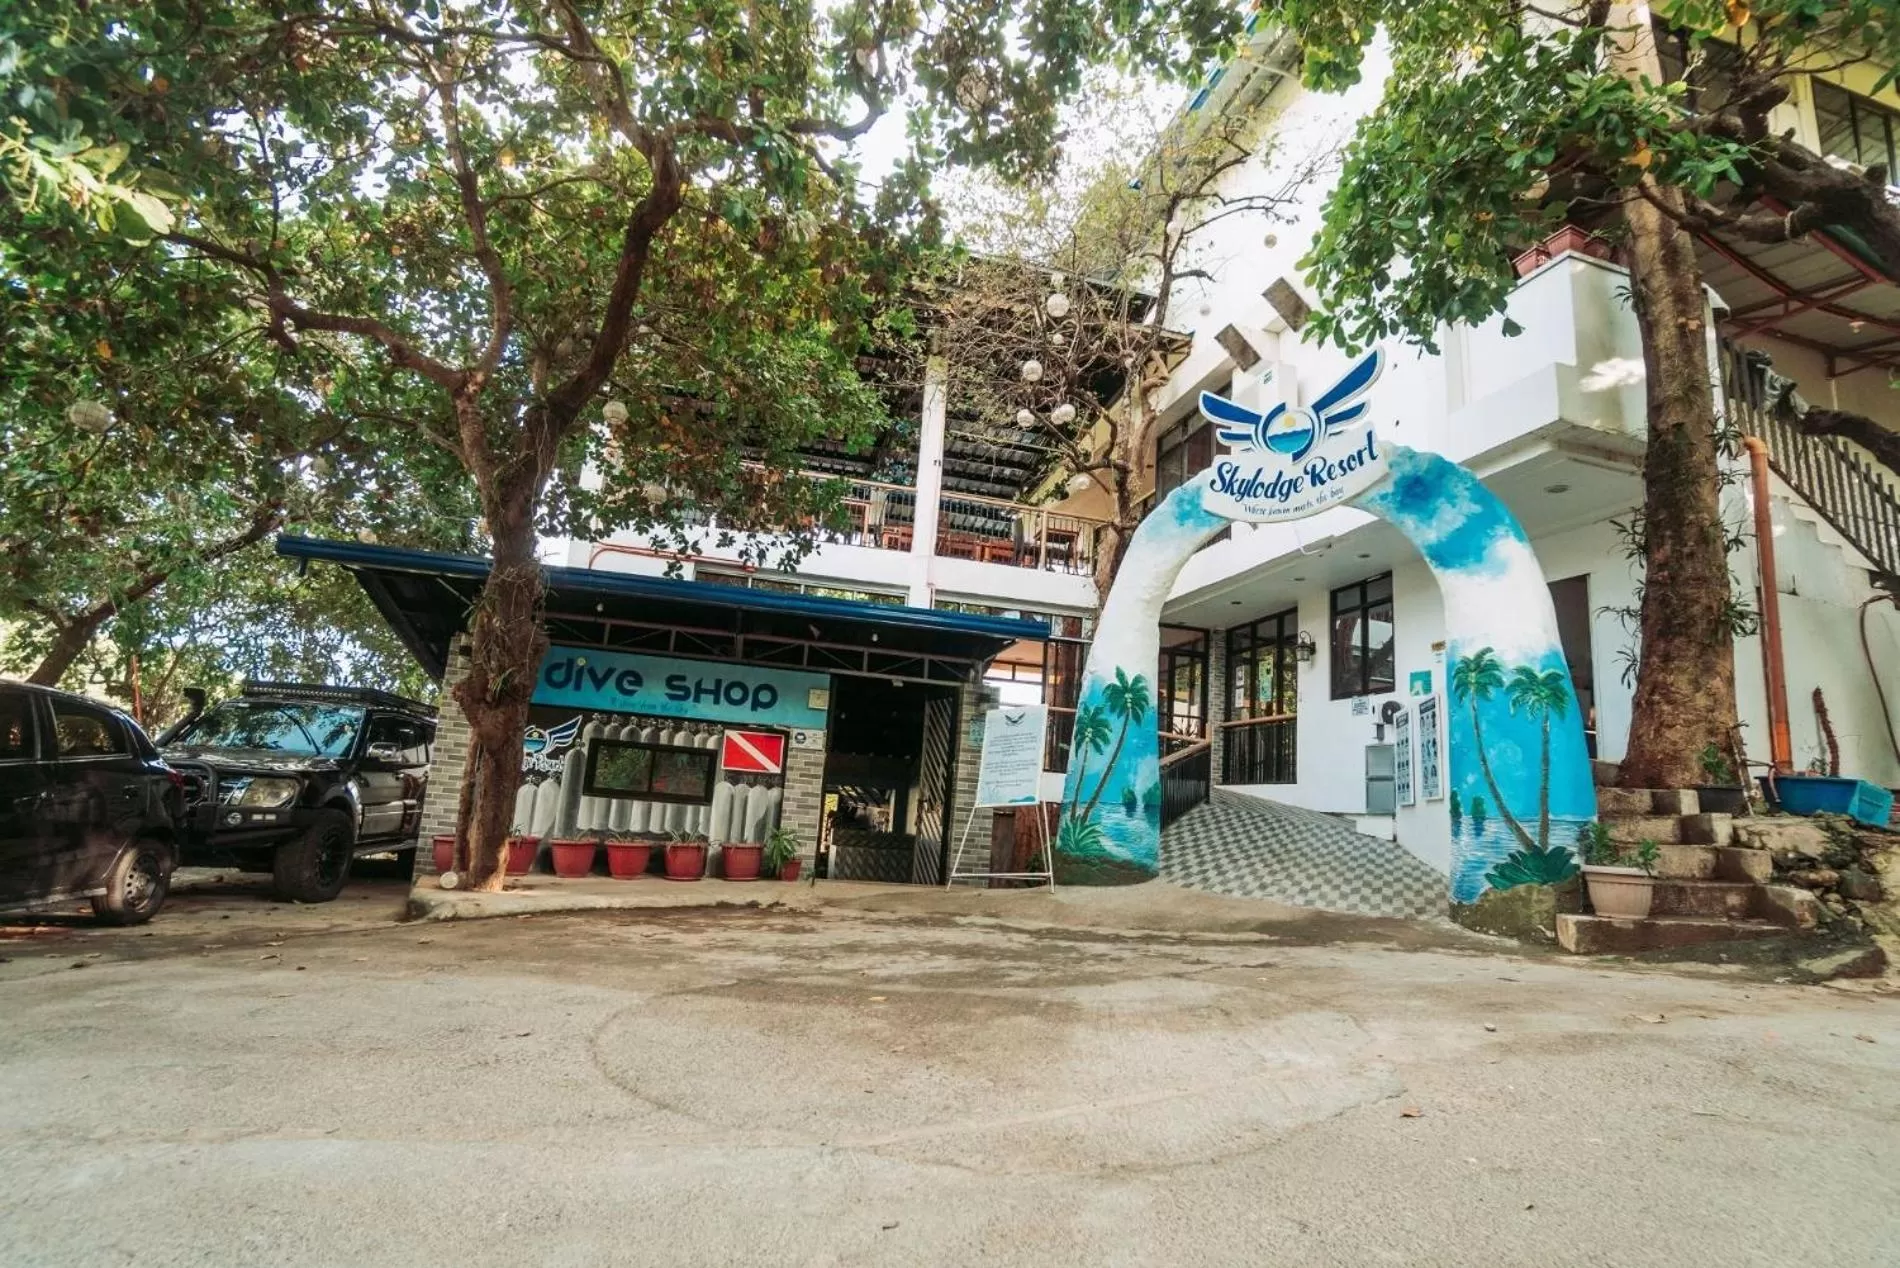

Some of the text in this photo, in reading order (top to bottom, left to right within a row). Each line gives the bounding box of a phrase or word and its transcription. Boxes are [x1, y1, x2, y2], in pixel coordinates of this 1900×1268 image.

[1210, 428, 1379, 503] Skylodge Resort
[544, 656, 644, 697] dive
